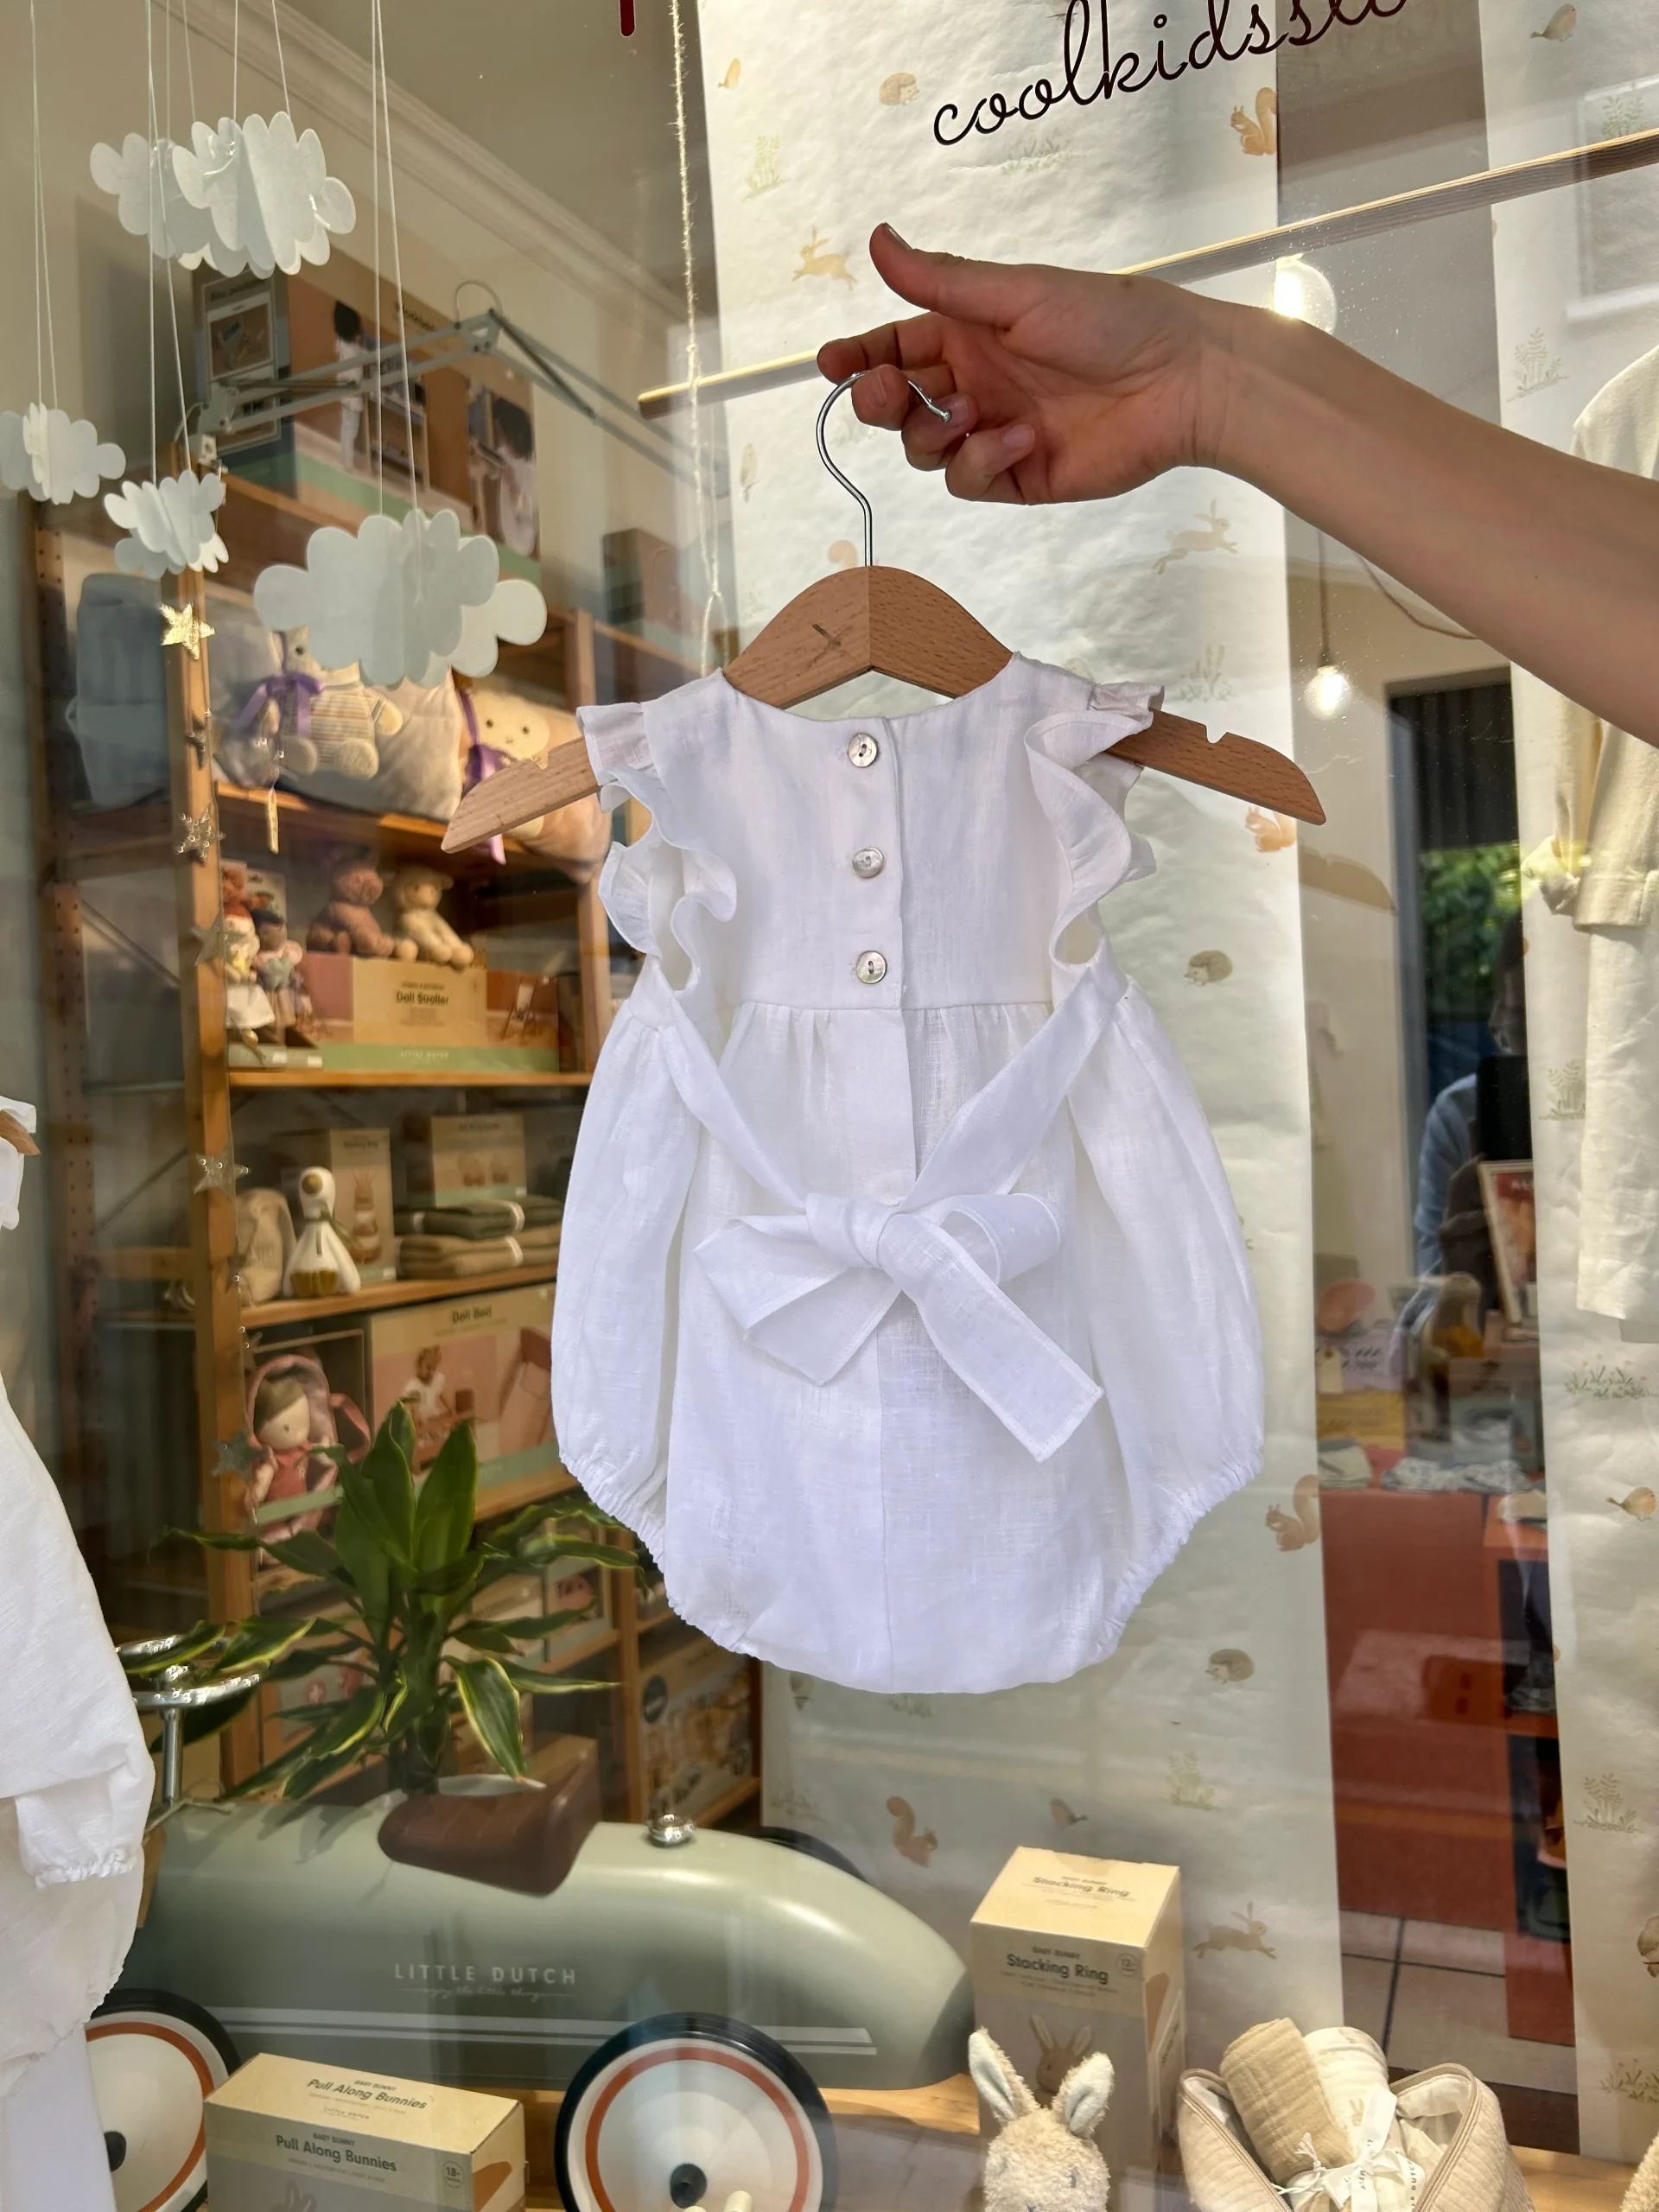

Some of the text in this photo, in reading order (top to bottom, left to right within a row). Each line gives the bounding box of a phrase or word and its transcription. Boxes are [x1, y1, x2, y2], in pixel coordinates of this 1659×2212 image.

[396, 991, 449, 1005] Doll Stroller
[452, 1309, 471, 1325] Doll
[395, 1963, 575, 1985] LITTLE DUTCH
[1007, 1953, 1070, 1979] Stacking
[1074, 1963, 1109, 1985] Ring
[307, 2078, 334, 2091] Pull
[334, 2084, 373, 2101] Along
[375, 2091, 429, 2110] Bunnies
[276, 2134, 299, 2151] Pull
[303, 2140, 341, 2164] Along
[346, 2149, 397, 2171] Bunnies
